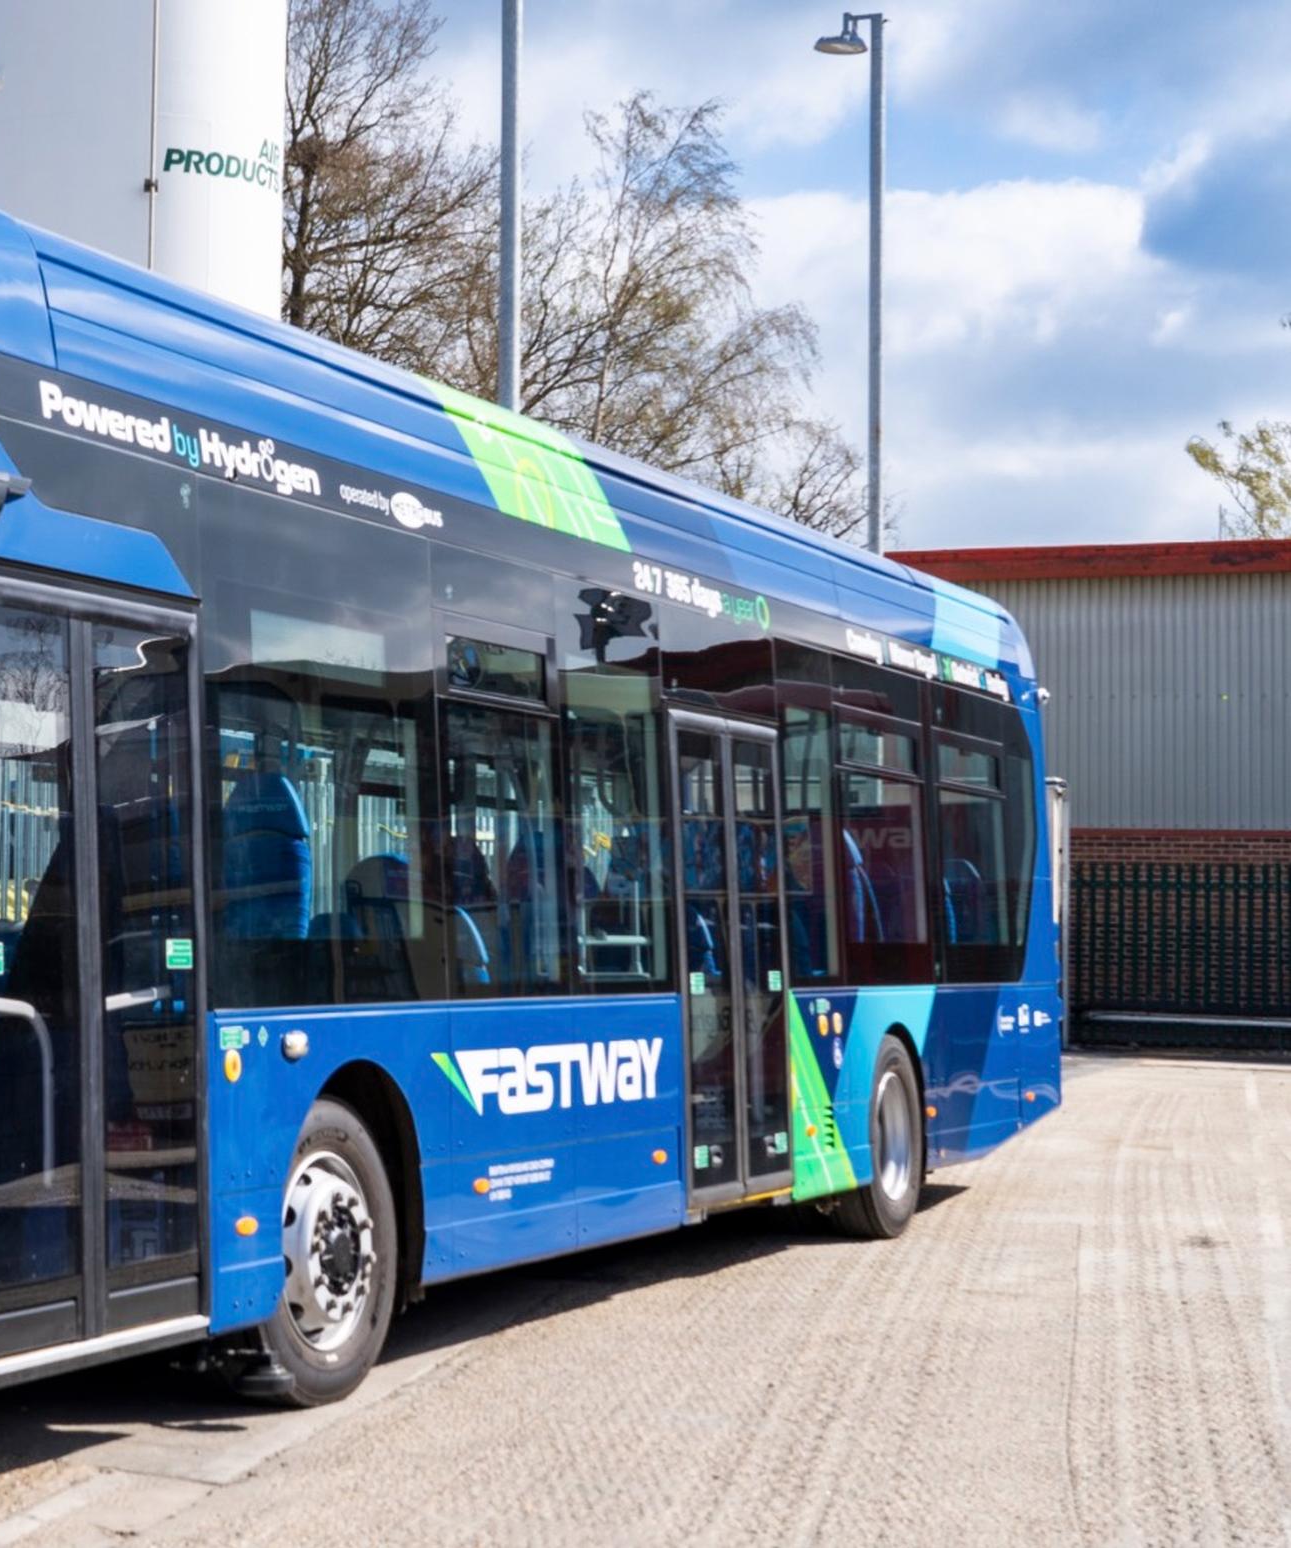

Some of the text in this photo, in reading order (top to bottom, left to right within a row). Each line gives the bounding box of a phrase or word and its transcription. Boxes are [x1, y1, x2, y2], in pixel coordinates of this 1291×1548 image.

[39, 380, 321, 496] Powered by Hydrogen
